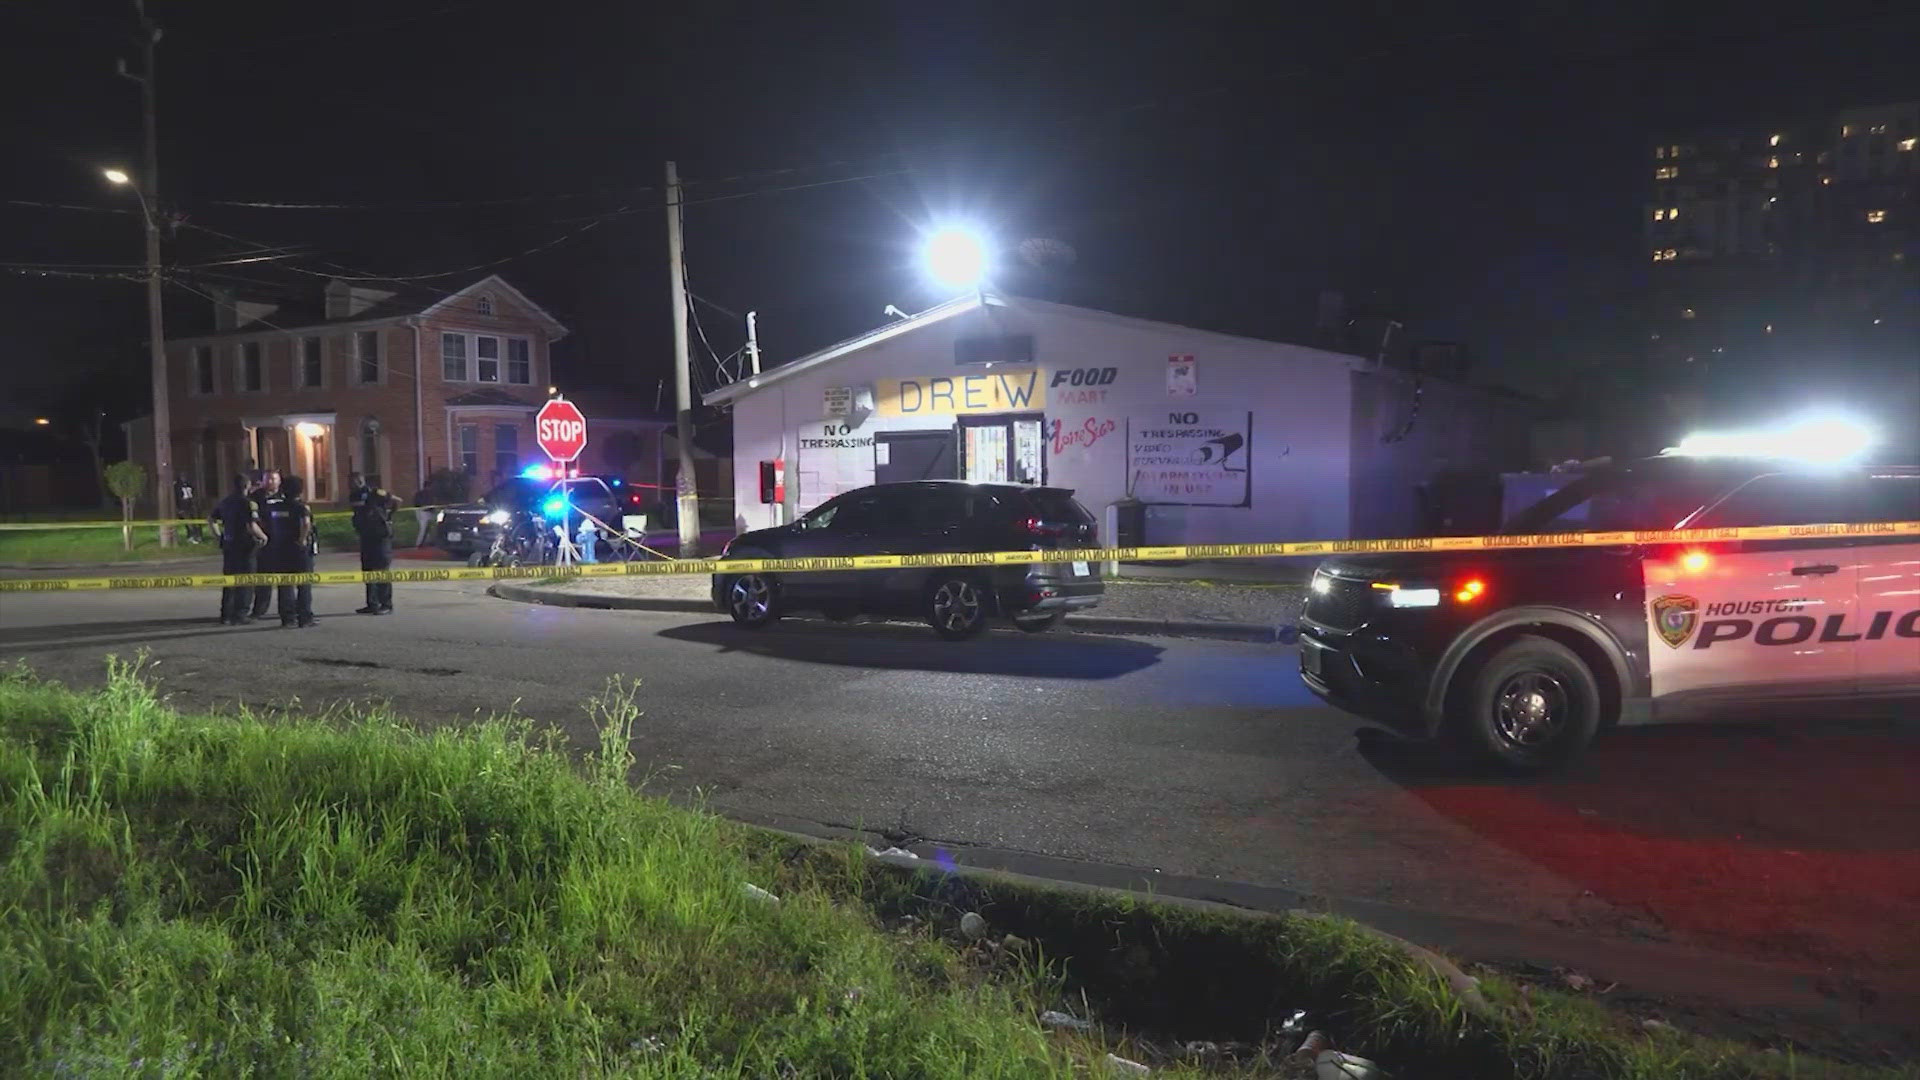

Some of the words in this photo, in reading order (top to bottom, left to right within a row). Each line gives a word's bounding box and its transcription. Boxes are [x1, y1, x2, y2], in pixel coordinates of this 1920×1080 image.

[1050, 367, 1118, 388] FOOD
[900, 371, 1037, 412] DREW
[1057, 389, 1107, 404] MART
[1168, 412, 1199, 425] NO
[541, 419, 582, 442] STOP
[824, 424, 851, 436] NO
[1140, 428, 1226, 439] TRESPASSING
[801, 437, 875, 448] TRESPASSING
[1134, 444, 1172, 453] VIDEO
[1706, 598, 1807, 617] HOUSTON
